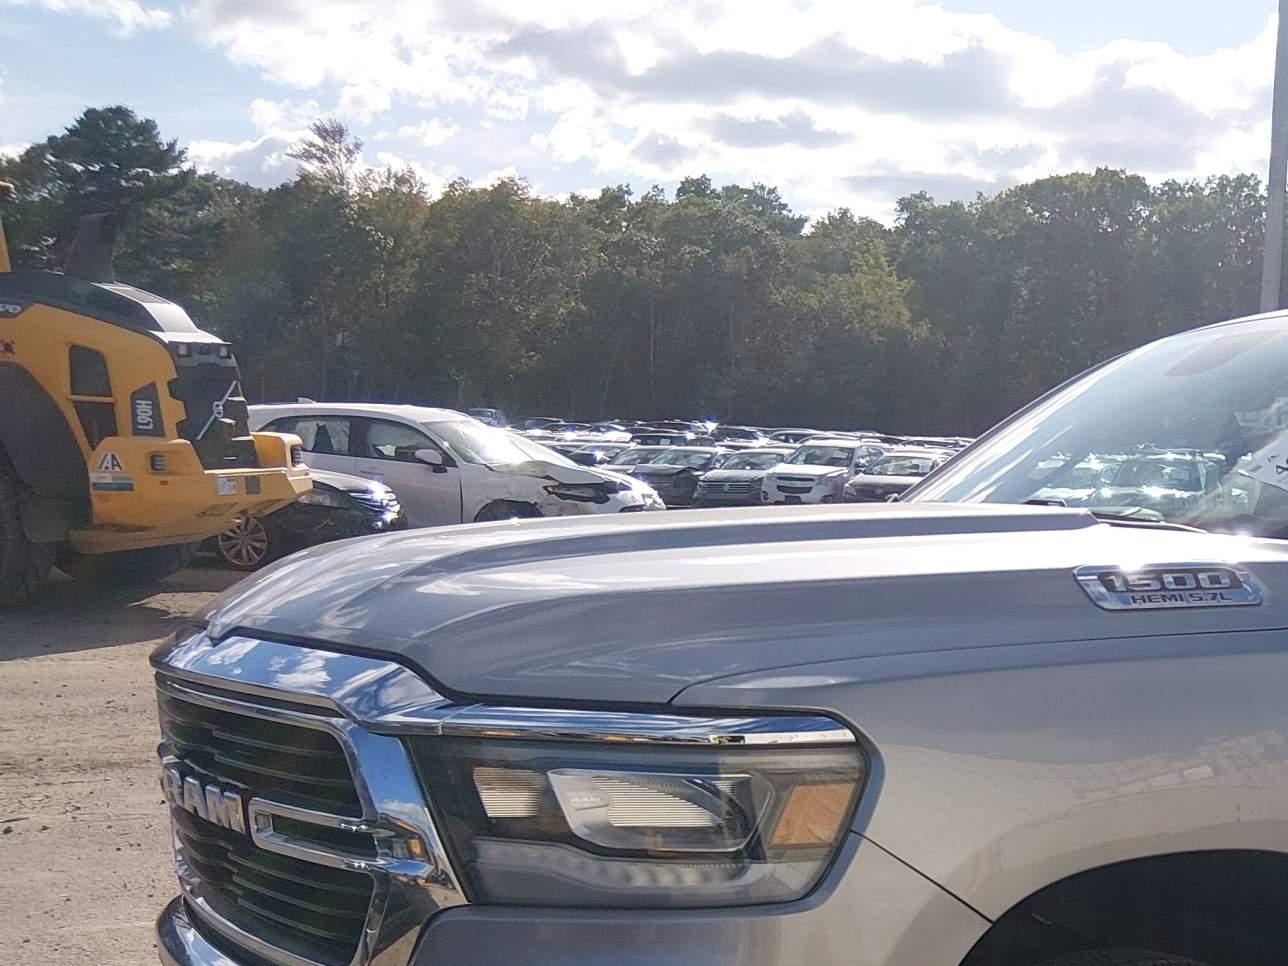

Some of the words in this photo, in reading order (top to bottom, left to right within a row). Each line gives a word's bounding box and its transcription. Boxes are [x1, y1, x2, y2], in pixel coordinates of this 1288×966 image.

[136, 400, 153, 430] L90H
[1103, 572, 1232, 592] 1500
[1129, 592, 1184, 605] HEMI
[1191, 592, 1233, 603] 5.7L
[164, 766, 247, 835] RAM
